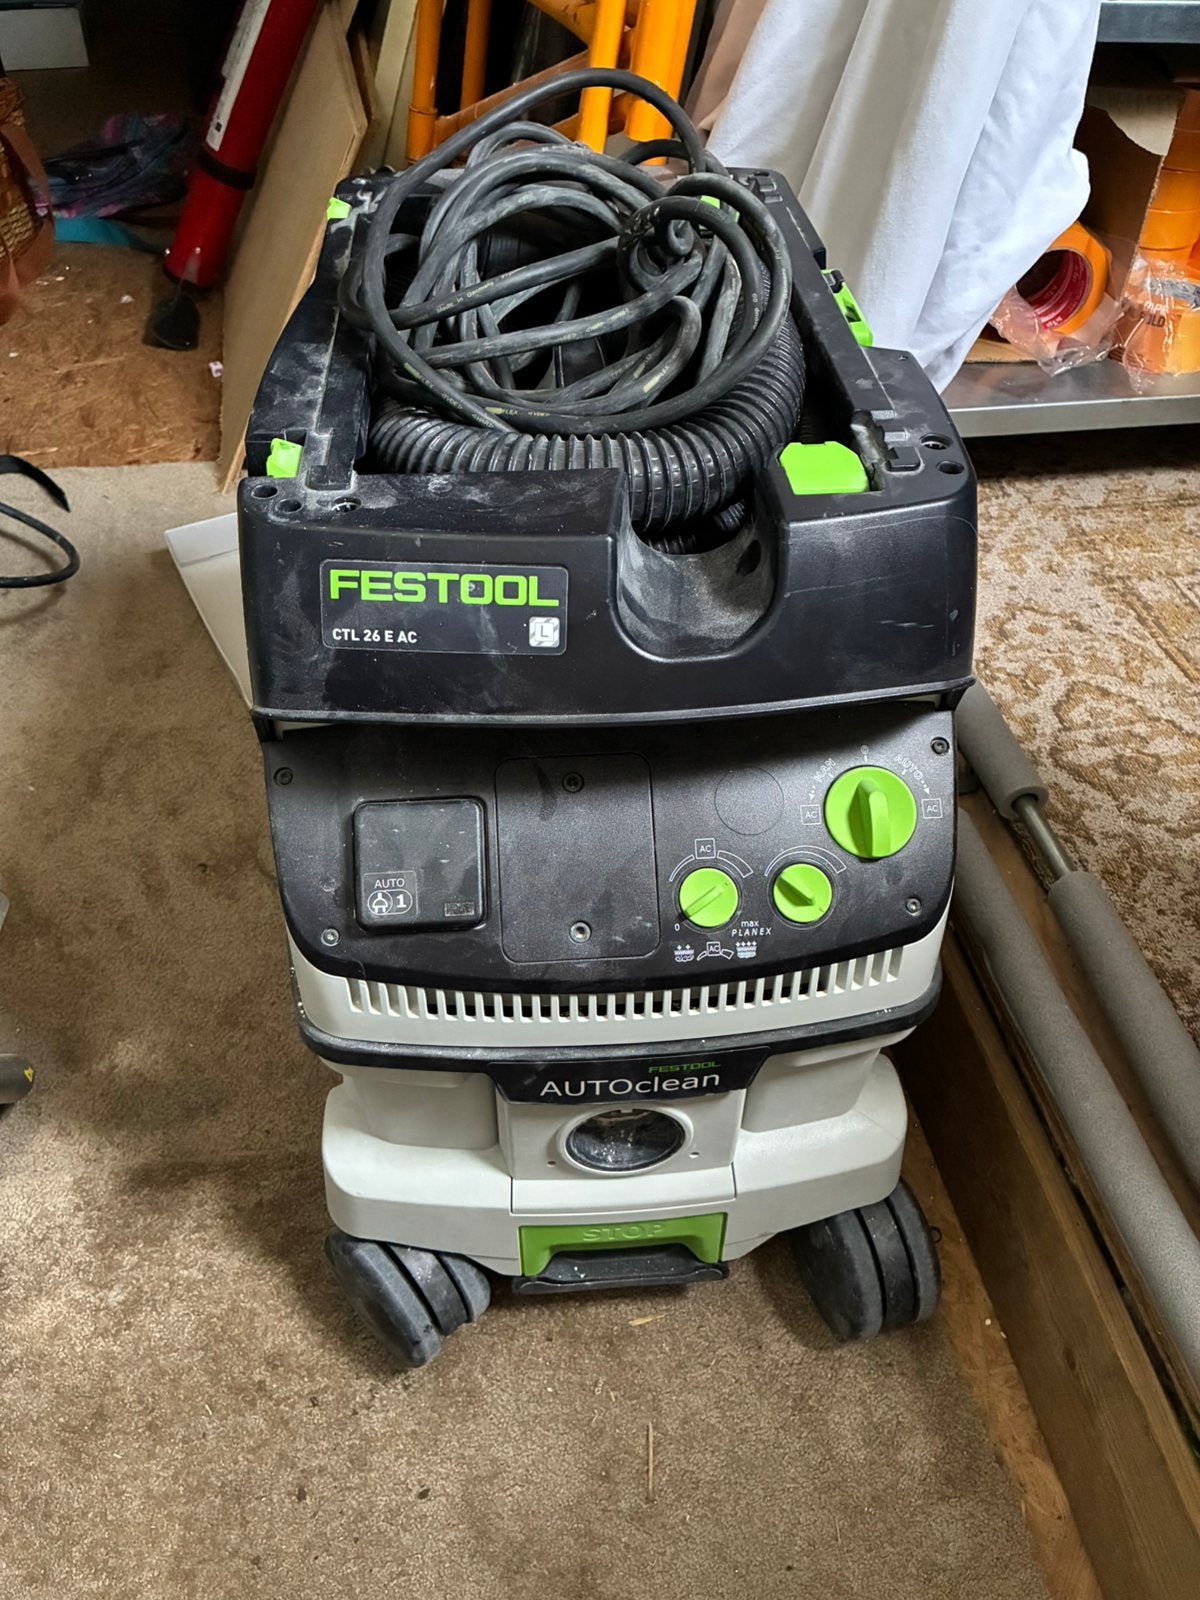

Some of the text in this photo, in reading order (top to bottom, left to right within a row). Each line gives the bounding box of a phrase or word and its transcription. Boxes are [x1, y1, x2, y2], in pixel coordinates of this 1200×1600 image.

[330, 569, 560, 607] FESTOOL
[332, 628, 418, 644] CTL 26 E AC
[894, 754, 924, 781] AUTO
[805, 811, 817, 819] AC
[926, 804, 938, 813] AC
[699, 844, 712, 853] AC
[374, 877, 405, 889] AUTO
[396, 893, 407, 908] 1
[731, 927, 772, 937] PLANEX
[648, 1061, 721, 1073] FESTOOL
[540, 1073, 720, 1097] AUTOclean
[583, 1223, 665, 1241] STOP
